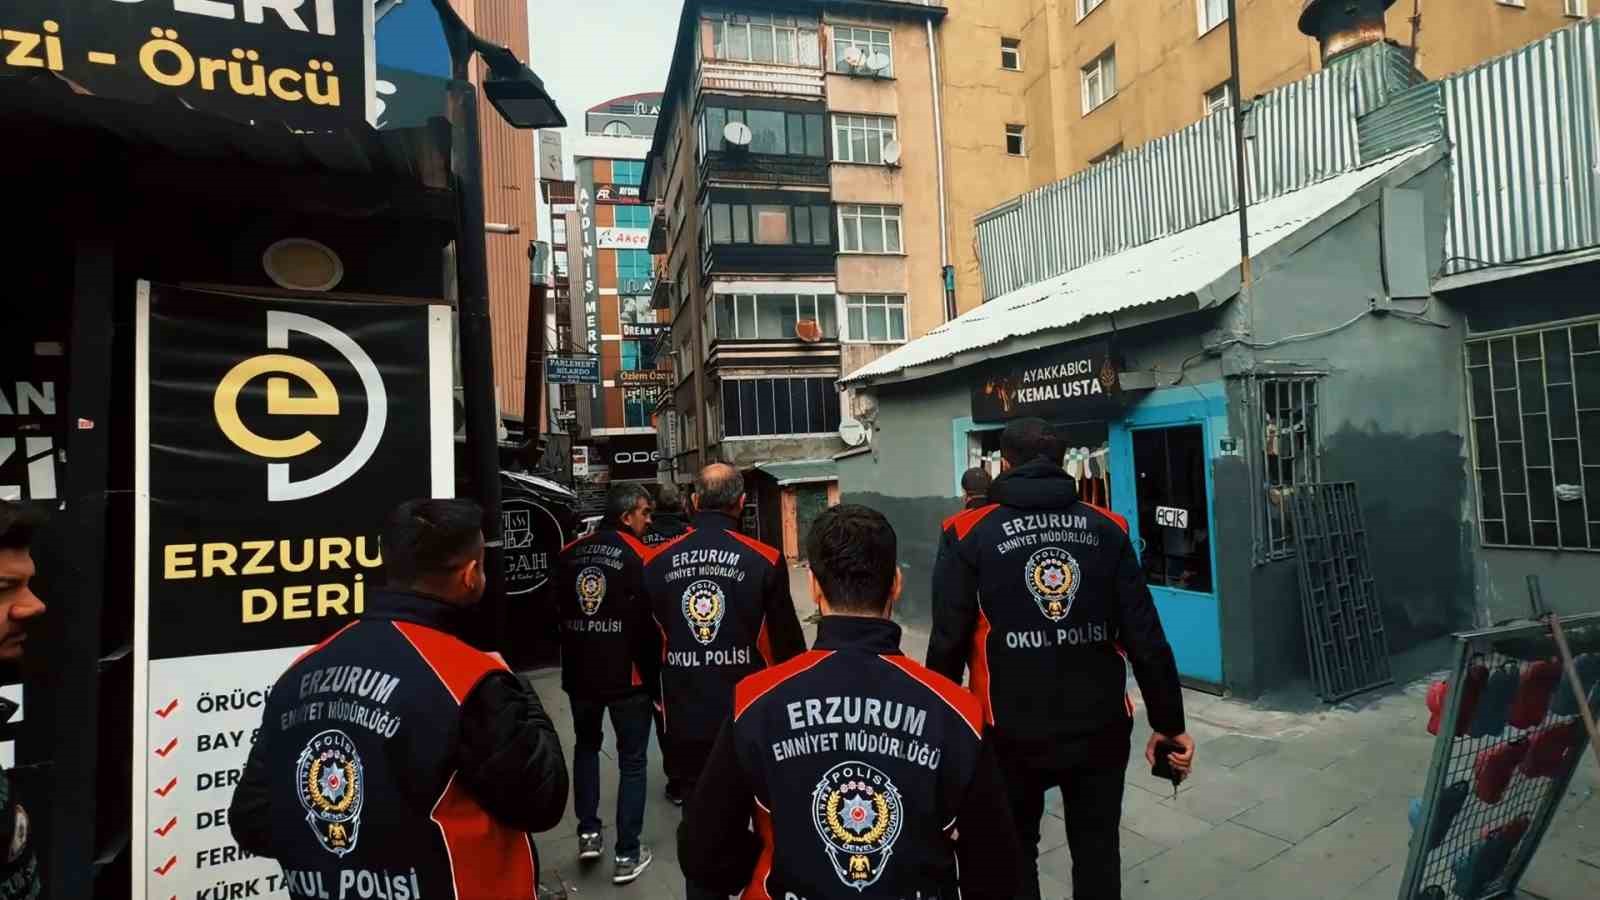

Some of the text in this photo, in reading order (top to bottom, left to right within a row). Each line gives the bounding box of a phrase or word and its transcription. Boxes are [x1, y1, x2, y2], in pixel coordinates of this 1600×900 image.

[0, 20, 64, 71] zi
[138, 26, 341, 107] Örücü
[623, 324, 651, 336] DREAM
[585, 300, 598, 399] MERKEİ
[1023, 359, 1092, 384] AYAKKABICI
[1017, 378, 1103, 404] KEMAL USTA
[1002, 513, 1088, 537] ERZURUM
[996, 533, 1038, 555] EMNİYET
[163, 535, 384, 580] ERZURU
[504, 552, 548, 574] GAH
[672, 549, 741, 568] ERZURUM
[241, 573, 365, 624] DERİ
[1006, 630, 1053, 649] OKUL
[667, 645, 751, 668] OKUL POLİSİ
[300, 665, 401, 705] ERZURUM
[328, 696, 401, 738] MÜDÜRLÜĞÜ
[786, 696, 927, 737] ERZURUM
[197, 730, 244, 753] BAY
[772, 729, 941, 771] EMNİYET MÜDÜRLÜĞÜ
[196, 762, 247, 791] DER
[831, 767, 883, 785] POLİS
[196, 808, 226, 830] DE
[196, 845, 256, 869] FERM
[196, 874, 288, 900] KÜRK TA
[285, 866, 421, 900] KUL POLİSİ
